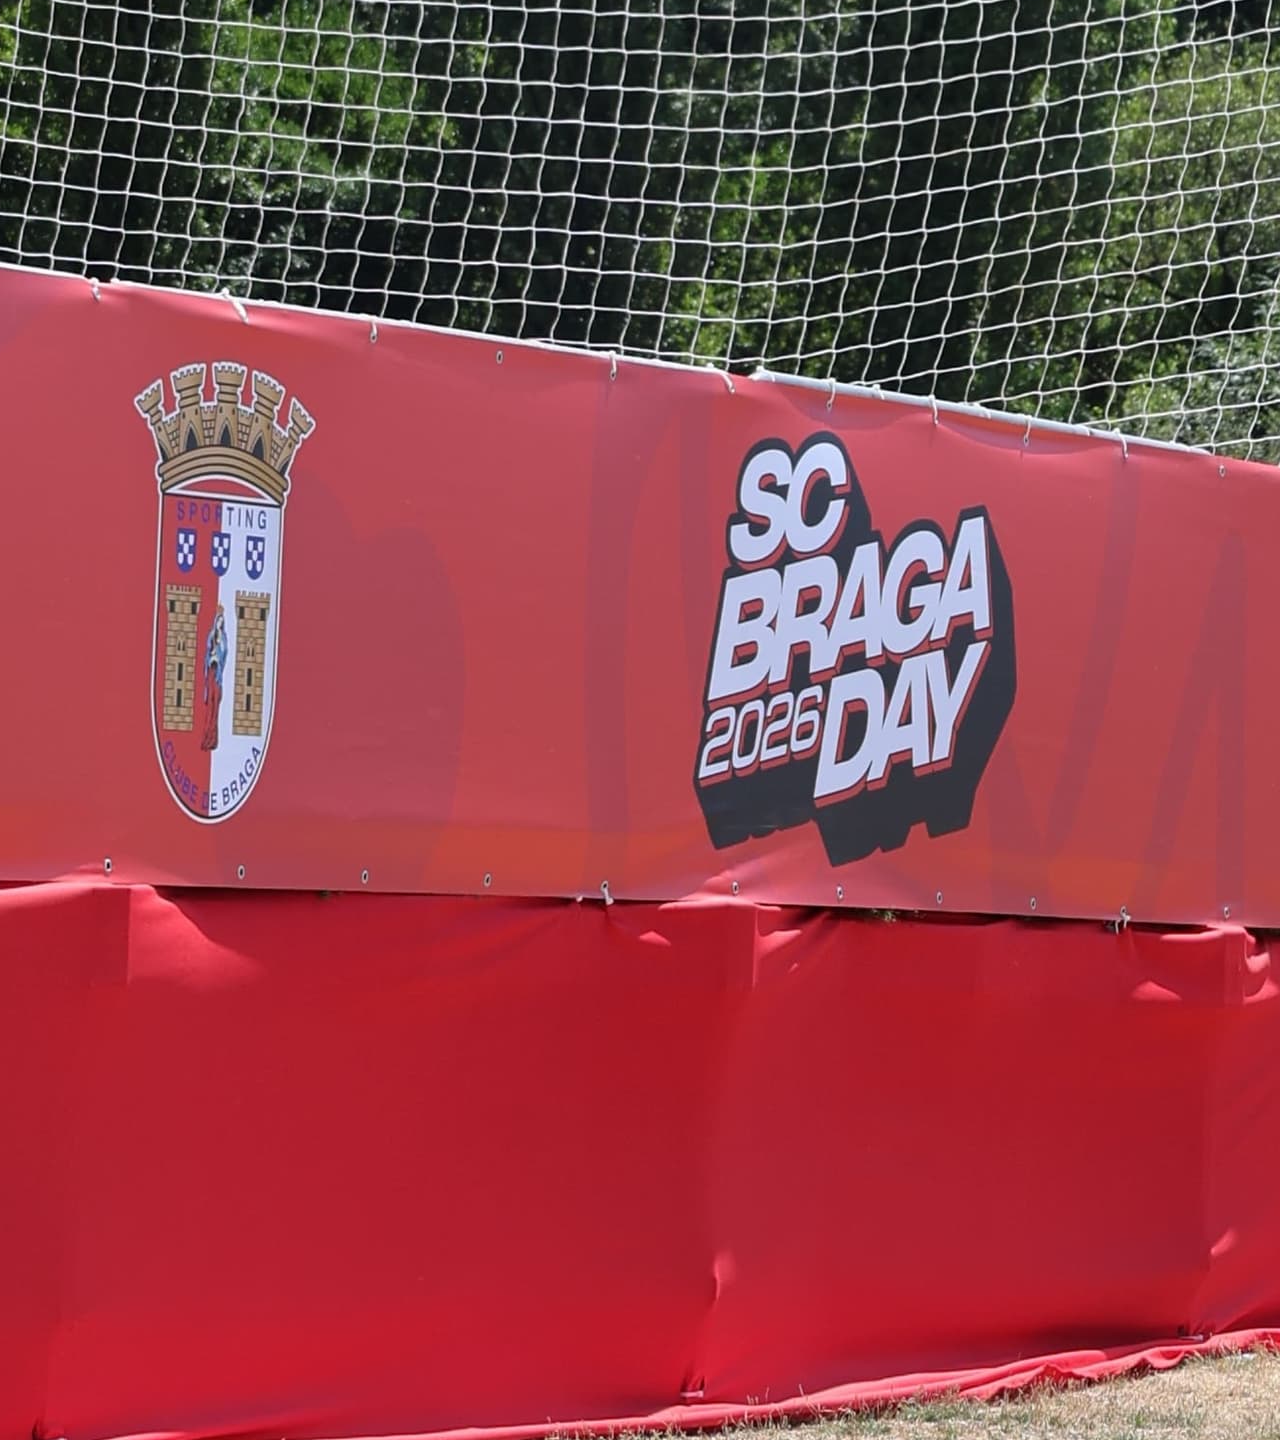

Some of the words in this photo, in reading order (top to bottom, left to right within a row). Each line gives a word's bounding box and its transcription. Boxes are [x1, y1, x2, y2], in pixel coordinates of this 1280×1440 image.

[177, 501, 267, 529] SPORTING
[730, 442, 847, 562] SC
[708, 516, 990, 701] BRAGA
[164, 741, 198, 803] CLUBE
[222, 746, 261, 806] BRAGA
[698, 685, 823, 780] 2026
[813, 641, 990, 799] DAY
